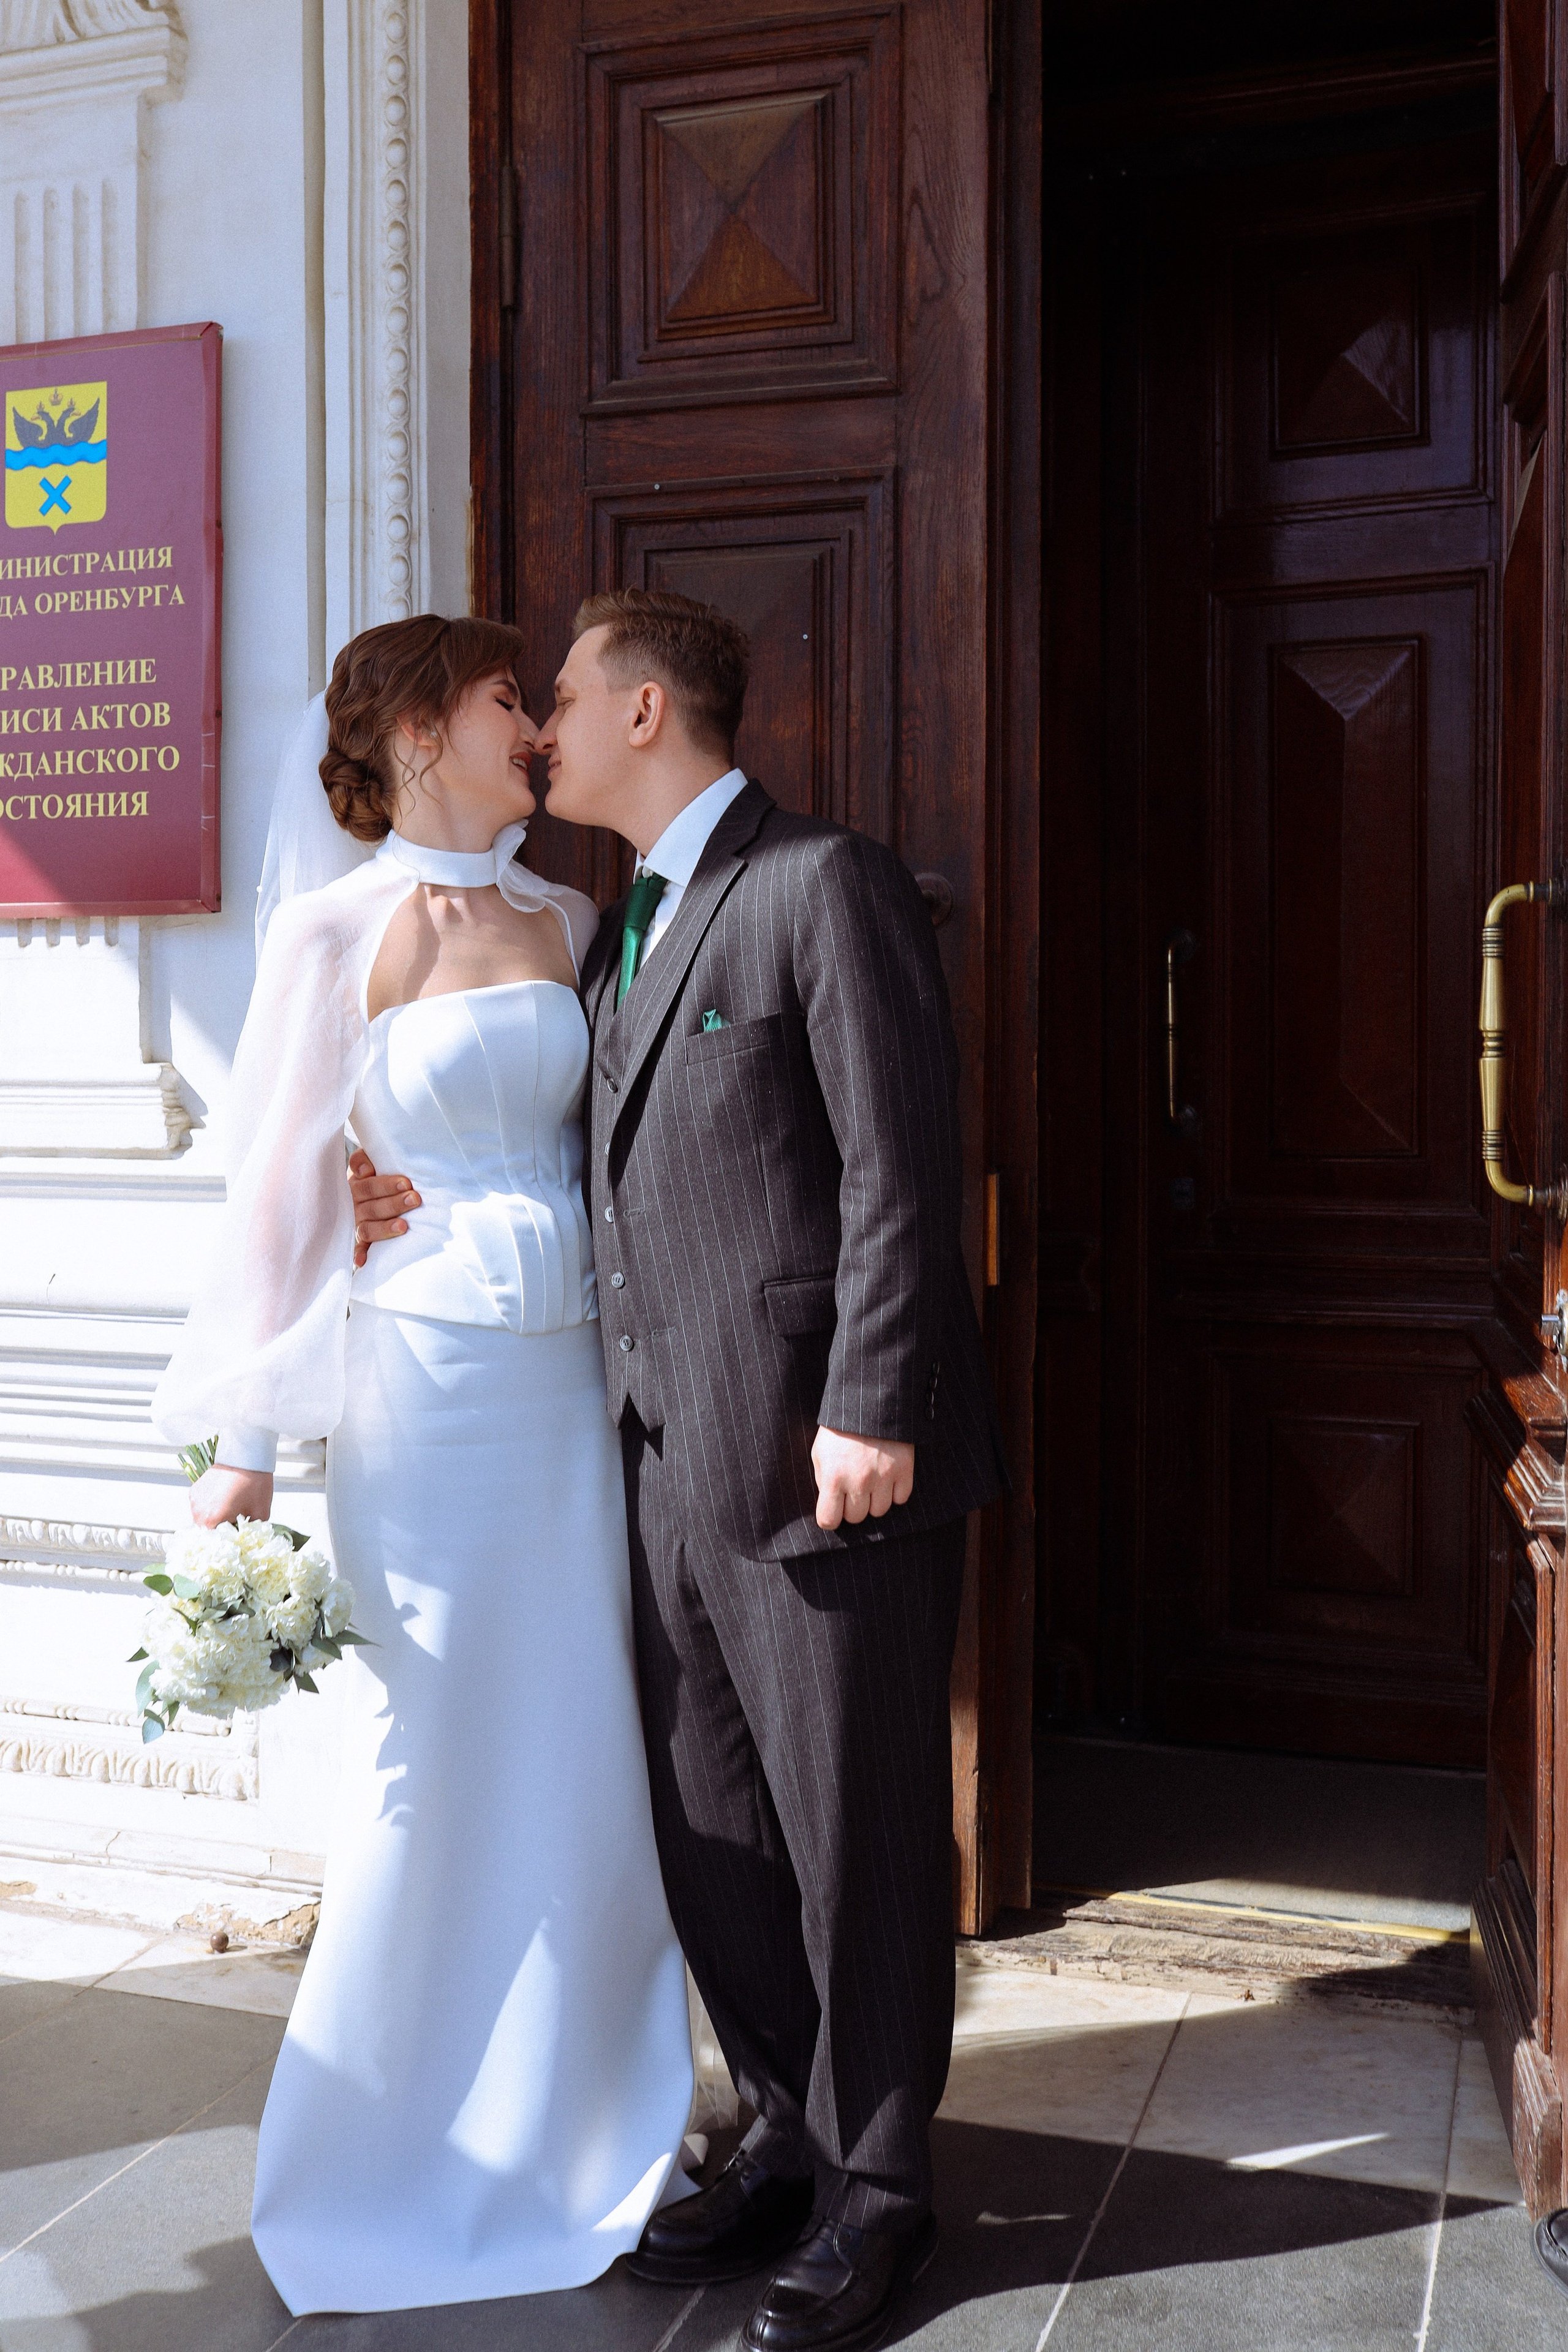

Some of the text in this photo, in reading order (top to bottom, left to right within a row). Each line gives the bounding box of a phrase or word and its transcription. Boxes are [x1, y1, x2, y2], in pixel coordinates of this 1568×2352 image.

[35, 584, 185, 614] ОРЕНБУРГА
[1, 658, 157, 692] РАВЛЕНИЕ
[1, 703, 172, 734] ИСИ АКТОВ
[0, 791, 149, 820] СТОЯНИЯ
